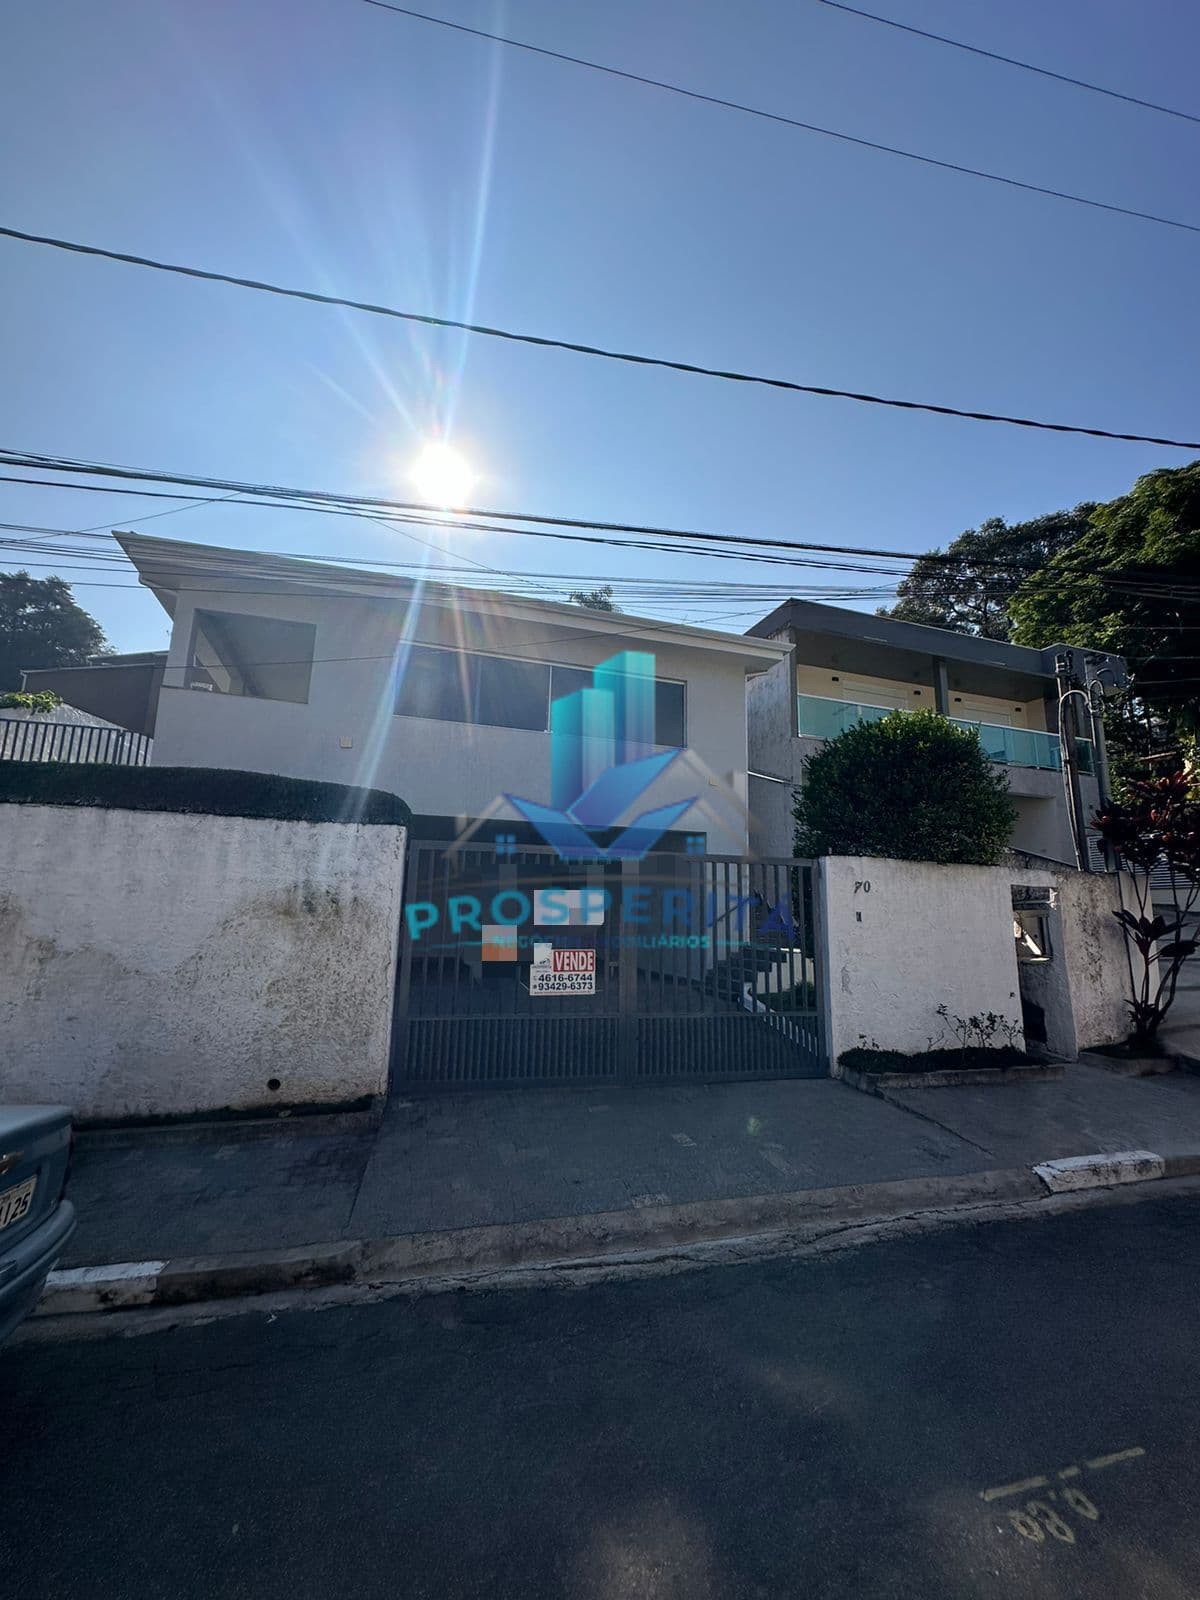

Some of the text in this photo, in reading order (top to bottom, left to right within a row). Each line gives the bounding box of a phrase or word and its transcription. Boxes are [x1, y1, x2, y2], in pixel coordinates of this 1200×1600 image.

[854, 880, 871, 894] 70
[555, 951, 594, 971] VENDE
[538, 973, 593, 982] 4616-6744
[538, 982, 593, 991] 93429-6373
[0, 1191, 31, 1226] 125
